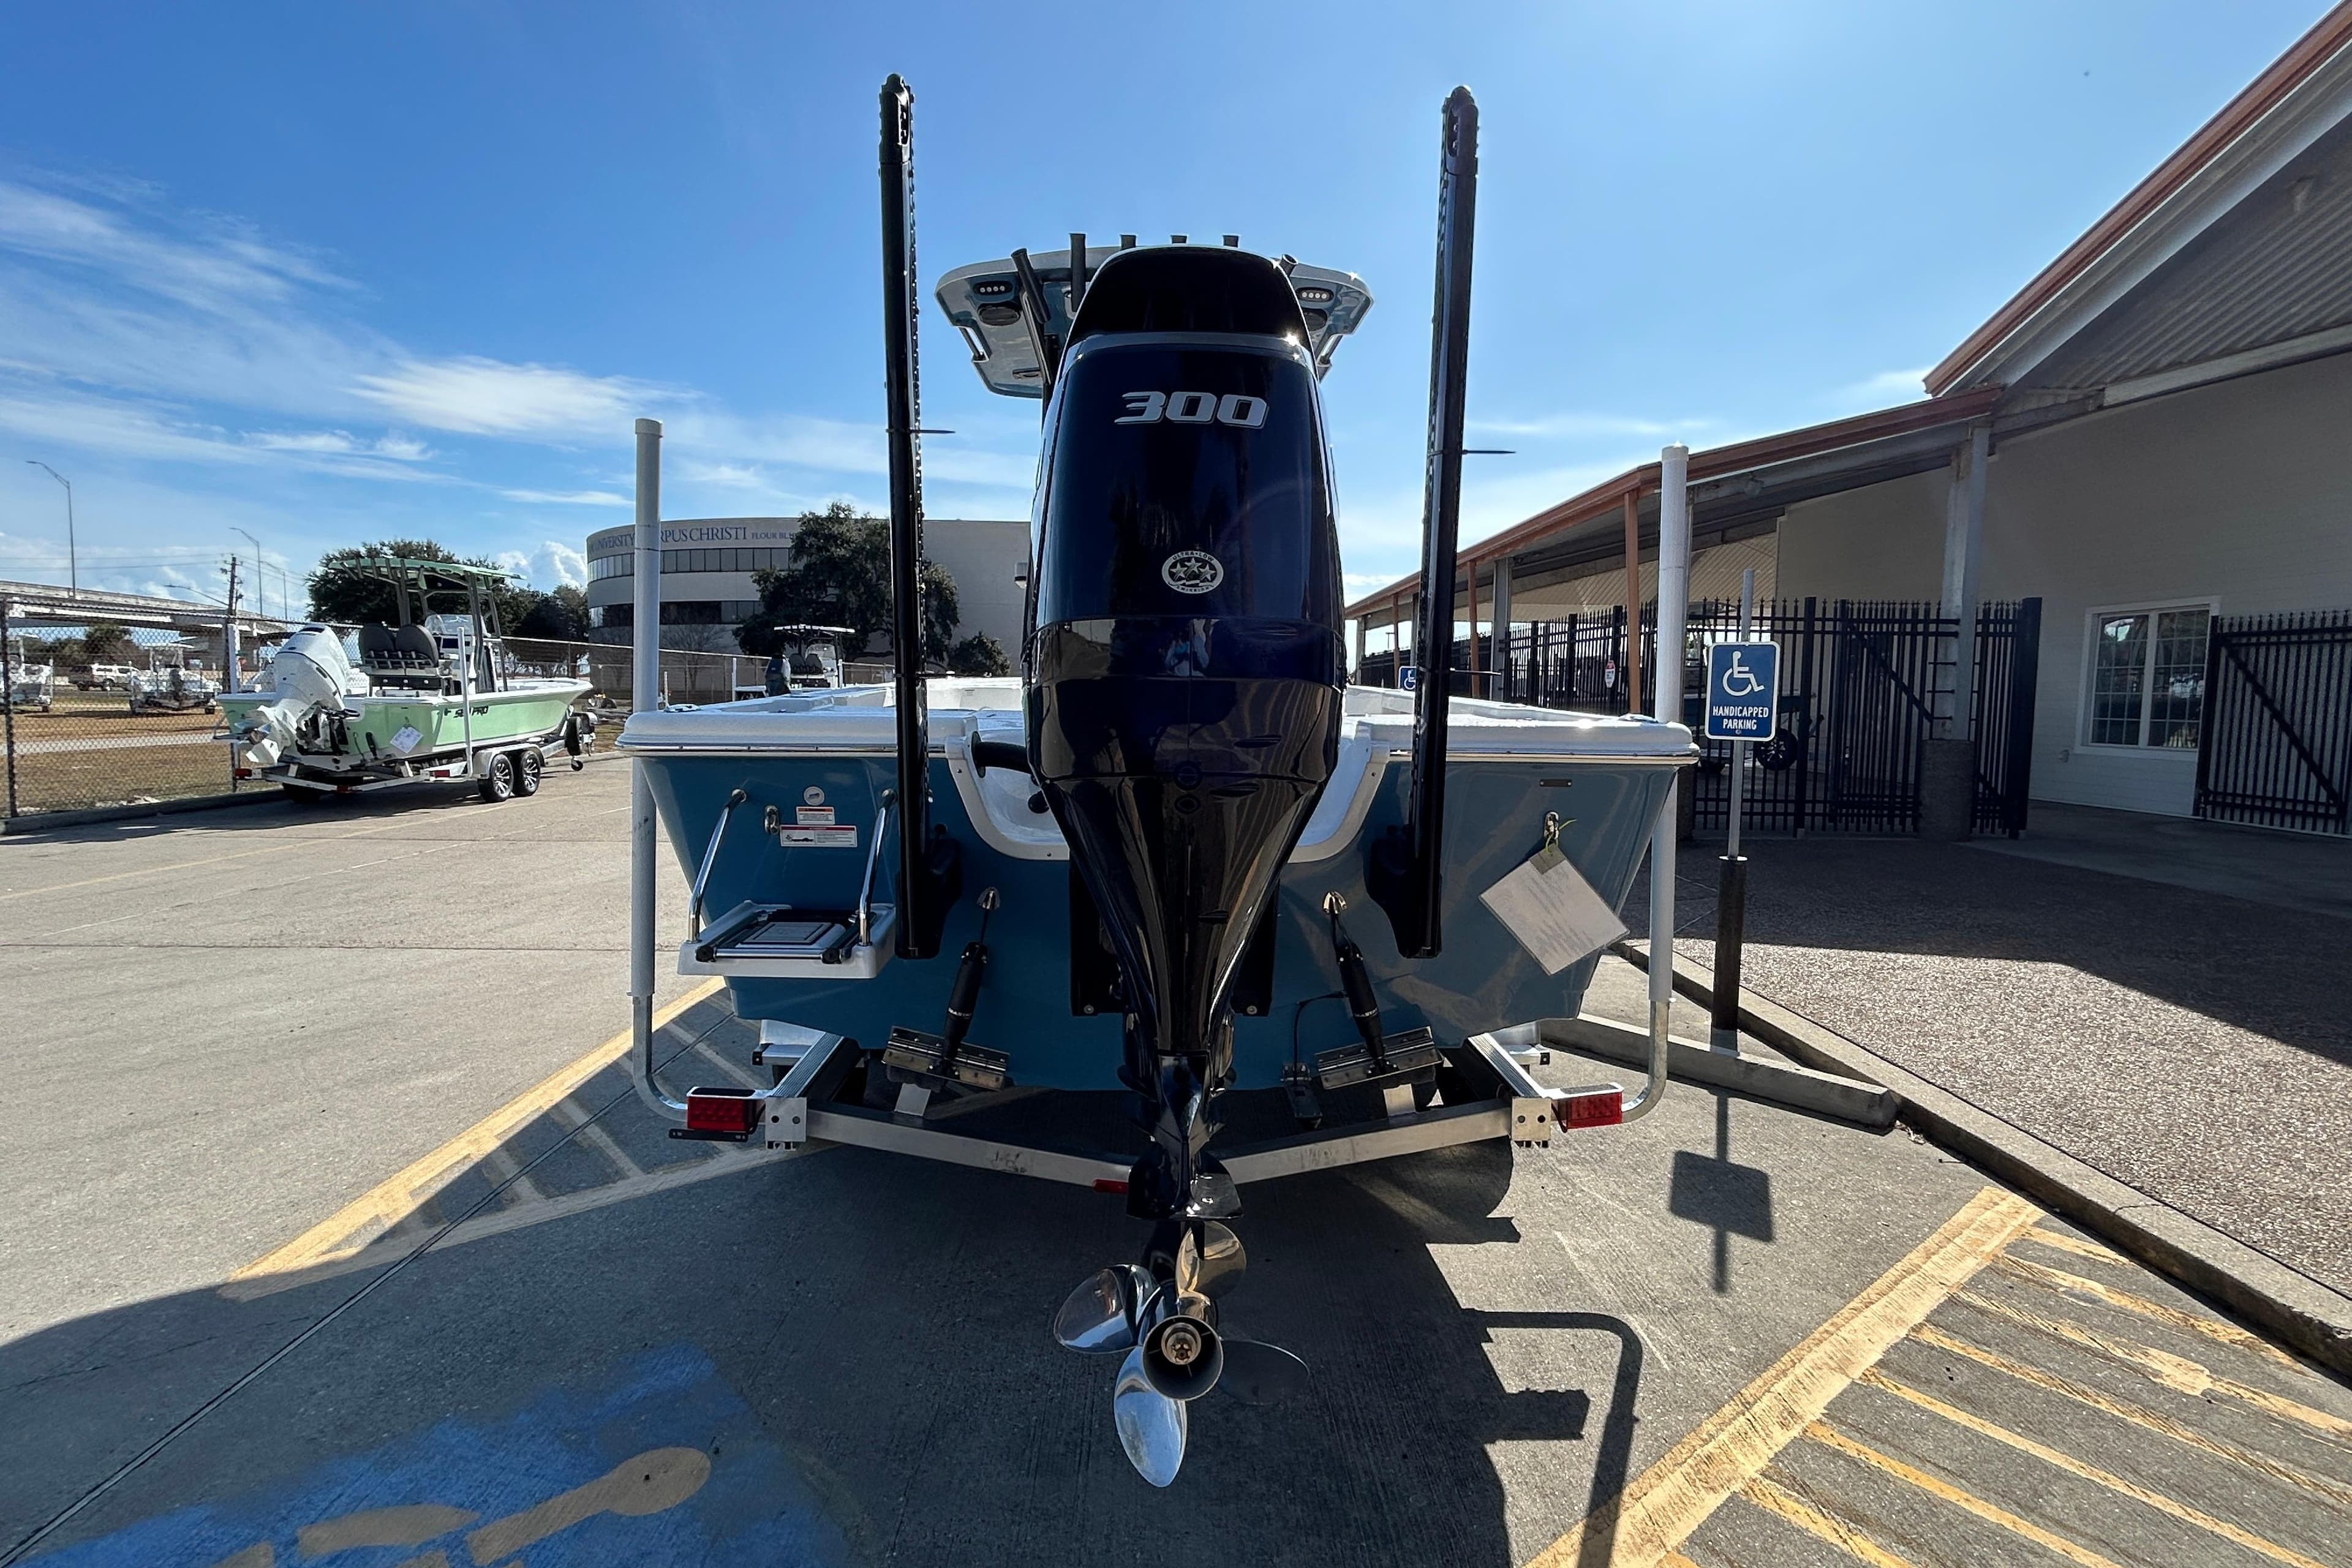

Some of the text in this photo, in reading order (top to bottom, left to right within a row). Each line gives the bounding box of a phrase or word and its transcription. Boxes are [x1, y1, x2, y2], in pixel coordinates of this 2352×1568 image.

[1114, 391, 1269, 429] 300
[690, 527, 747, 541] CHRISTI
[1713, 706, 1769, 718] HANDICAPPED
[1722, 718, 1757, 730] PARKING
